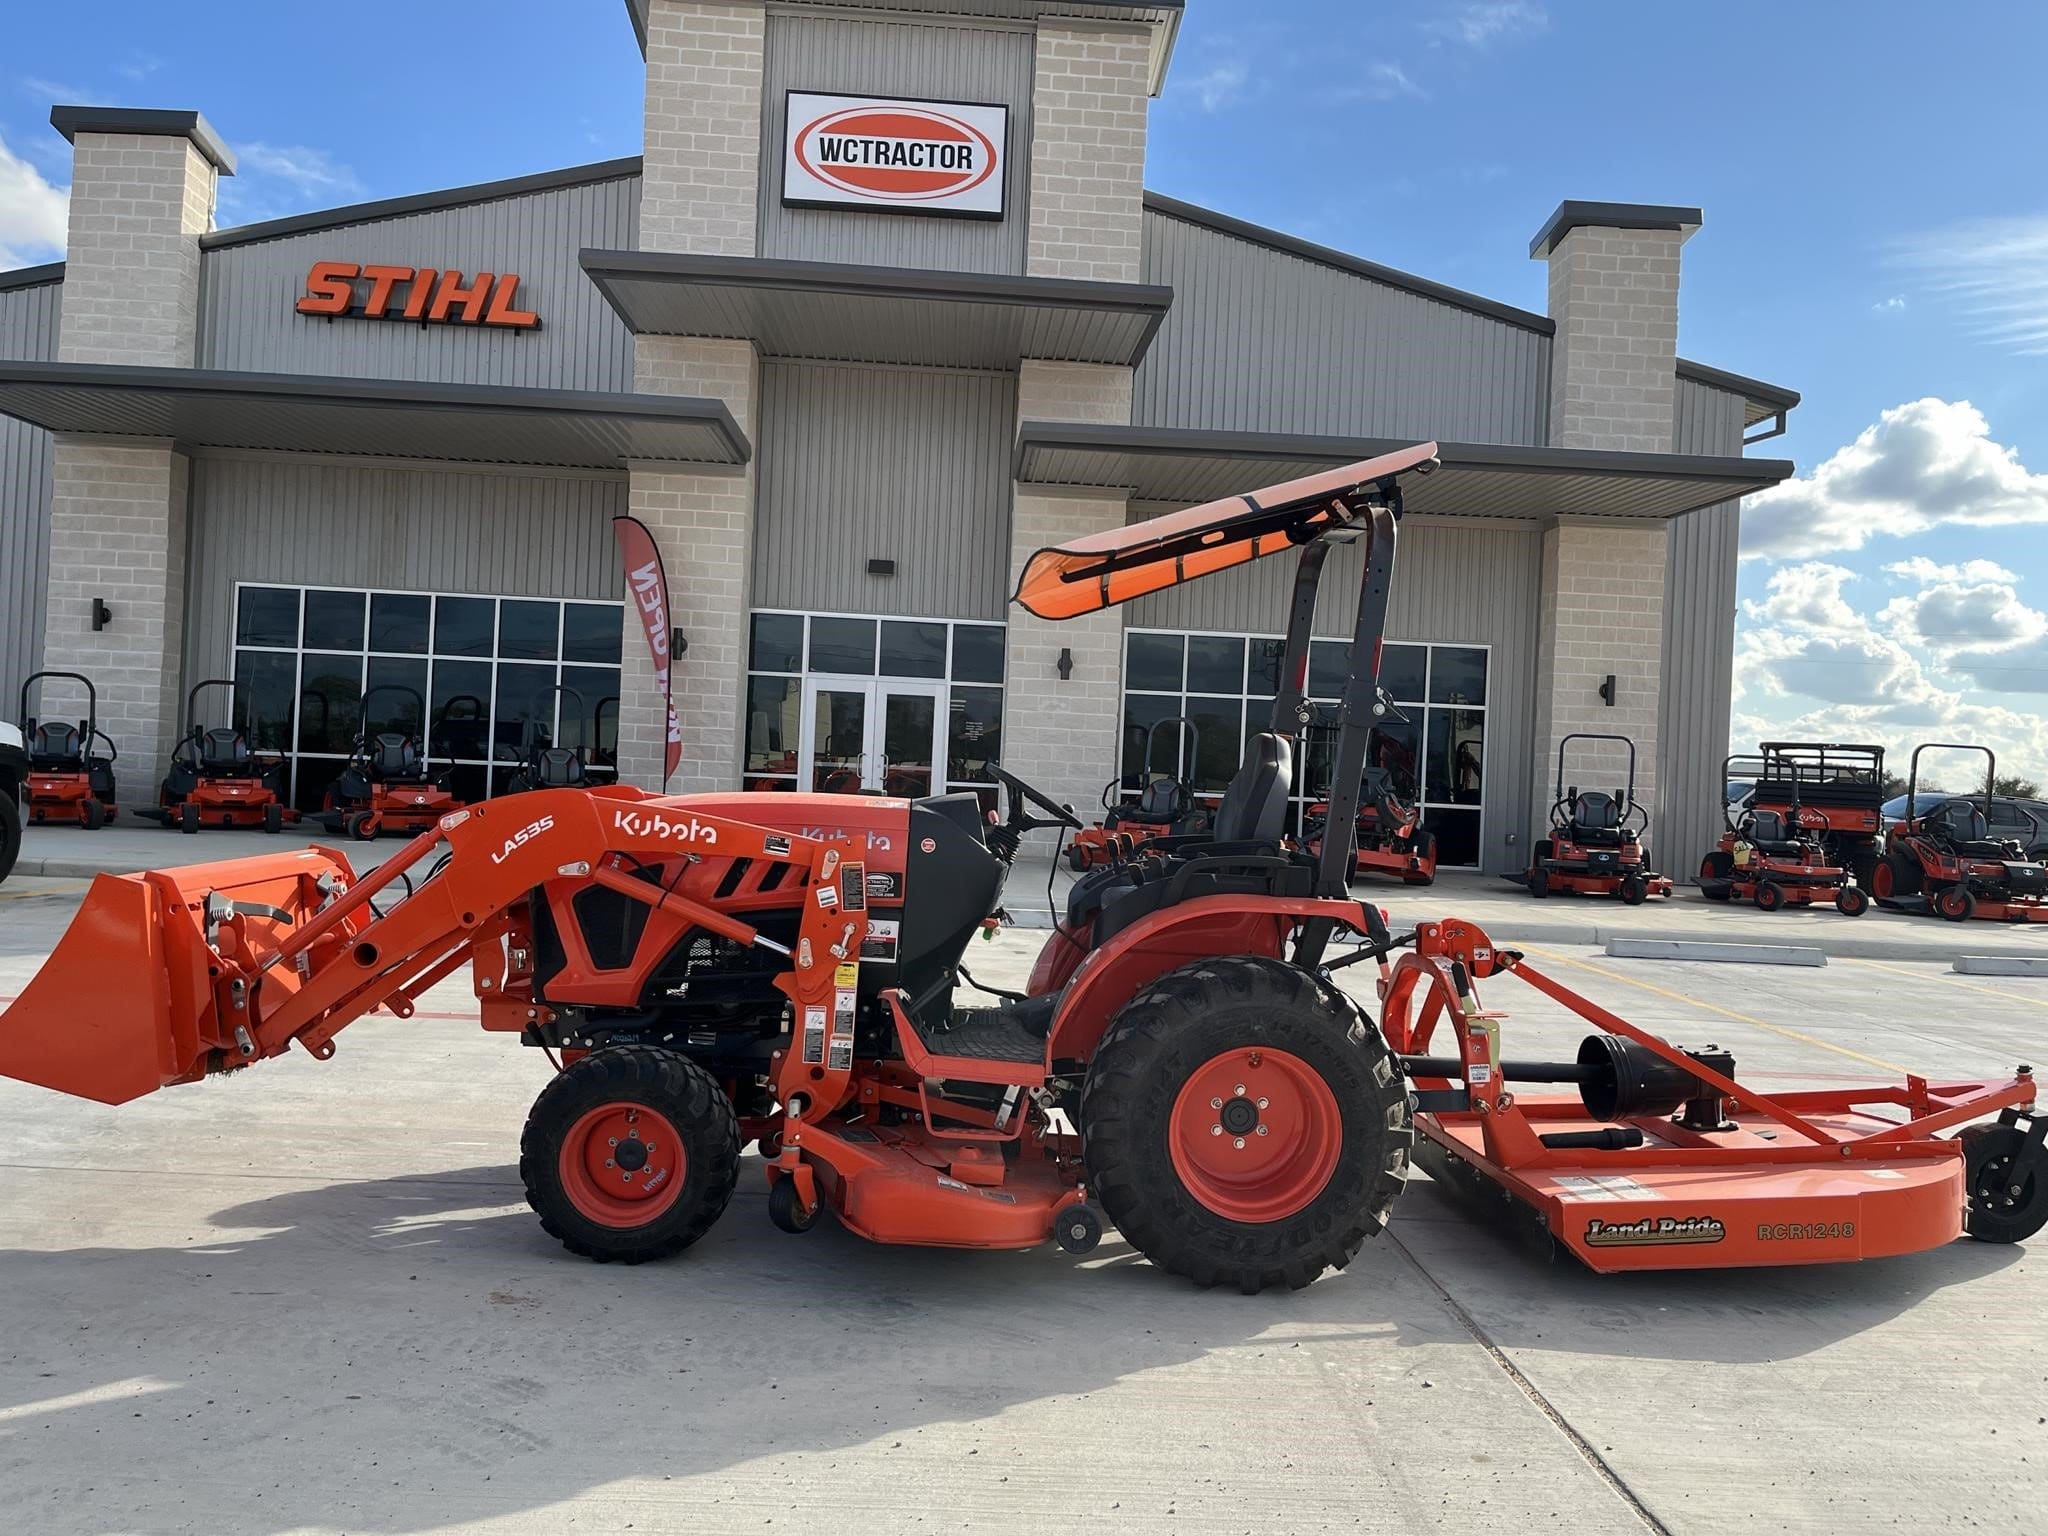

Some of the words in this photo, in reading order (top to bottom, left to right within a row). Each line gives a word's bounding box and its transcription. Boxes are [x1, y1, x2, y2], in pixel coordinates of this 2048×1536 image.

[818, 136, 973, 170] WCTRACTOR
[296, 261, 540, 328] STIHL
[613, 810, 718, 844] Kubota
[1798, 814, 1824, 823] Kubot
[490, 814, 555, 865] LA535
[1588, 1218, 1651, 1240] Land
[1656, 1216, 1725, 1239] Pride
[1757, 1222, 1856, 1241] RCR1248
